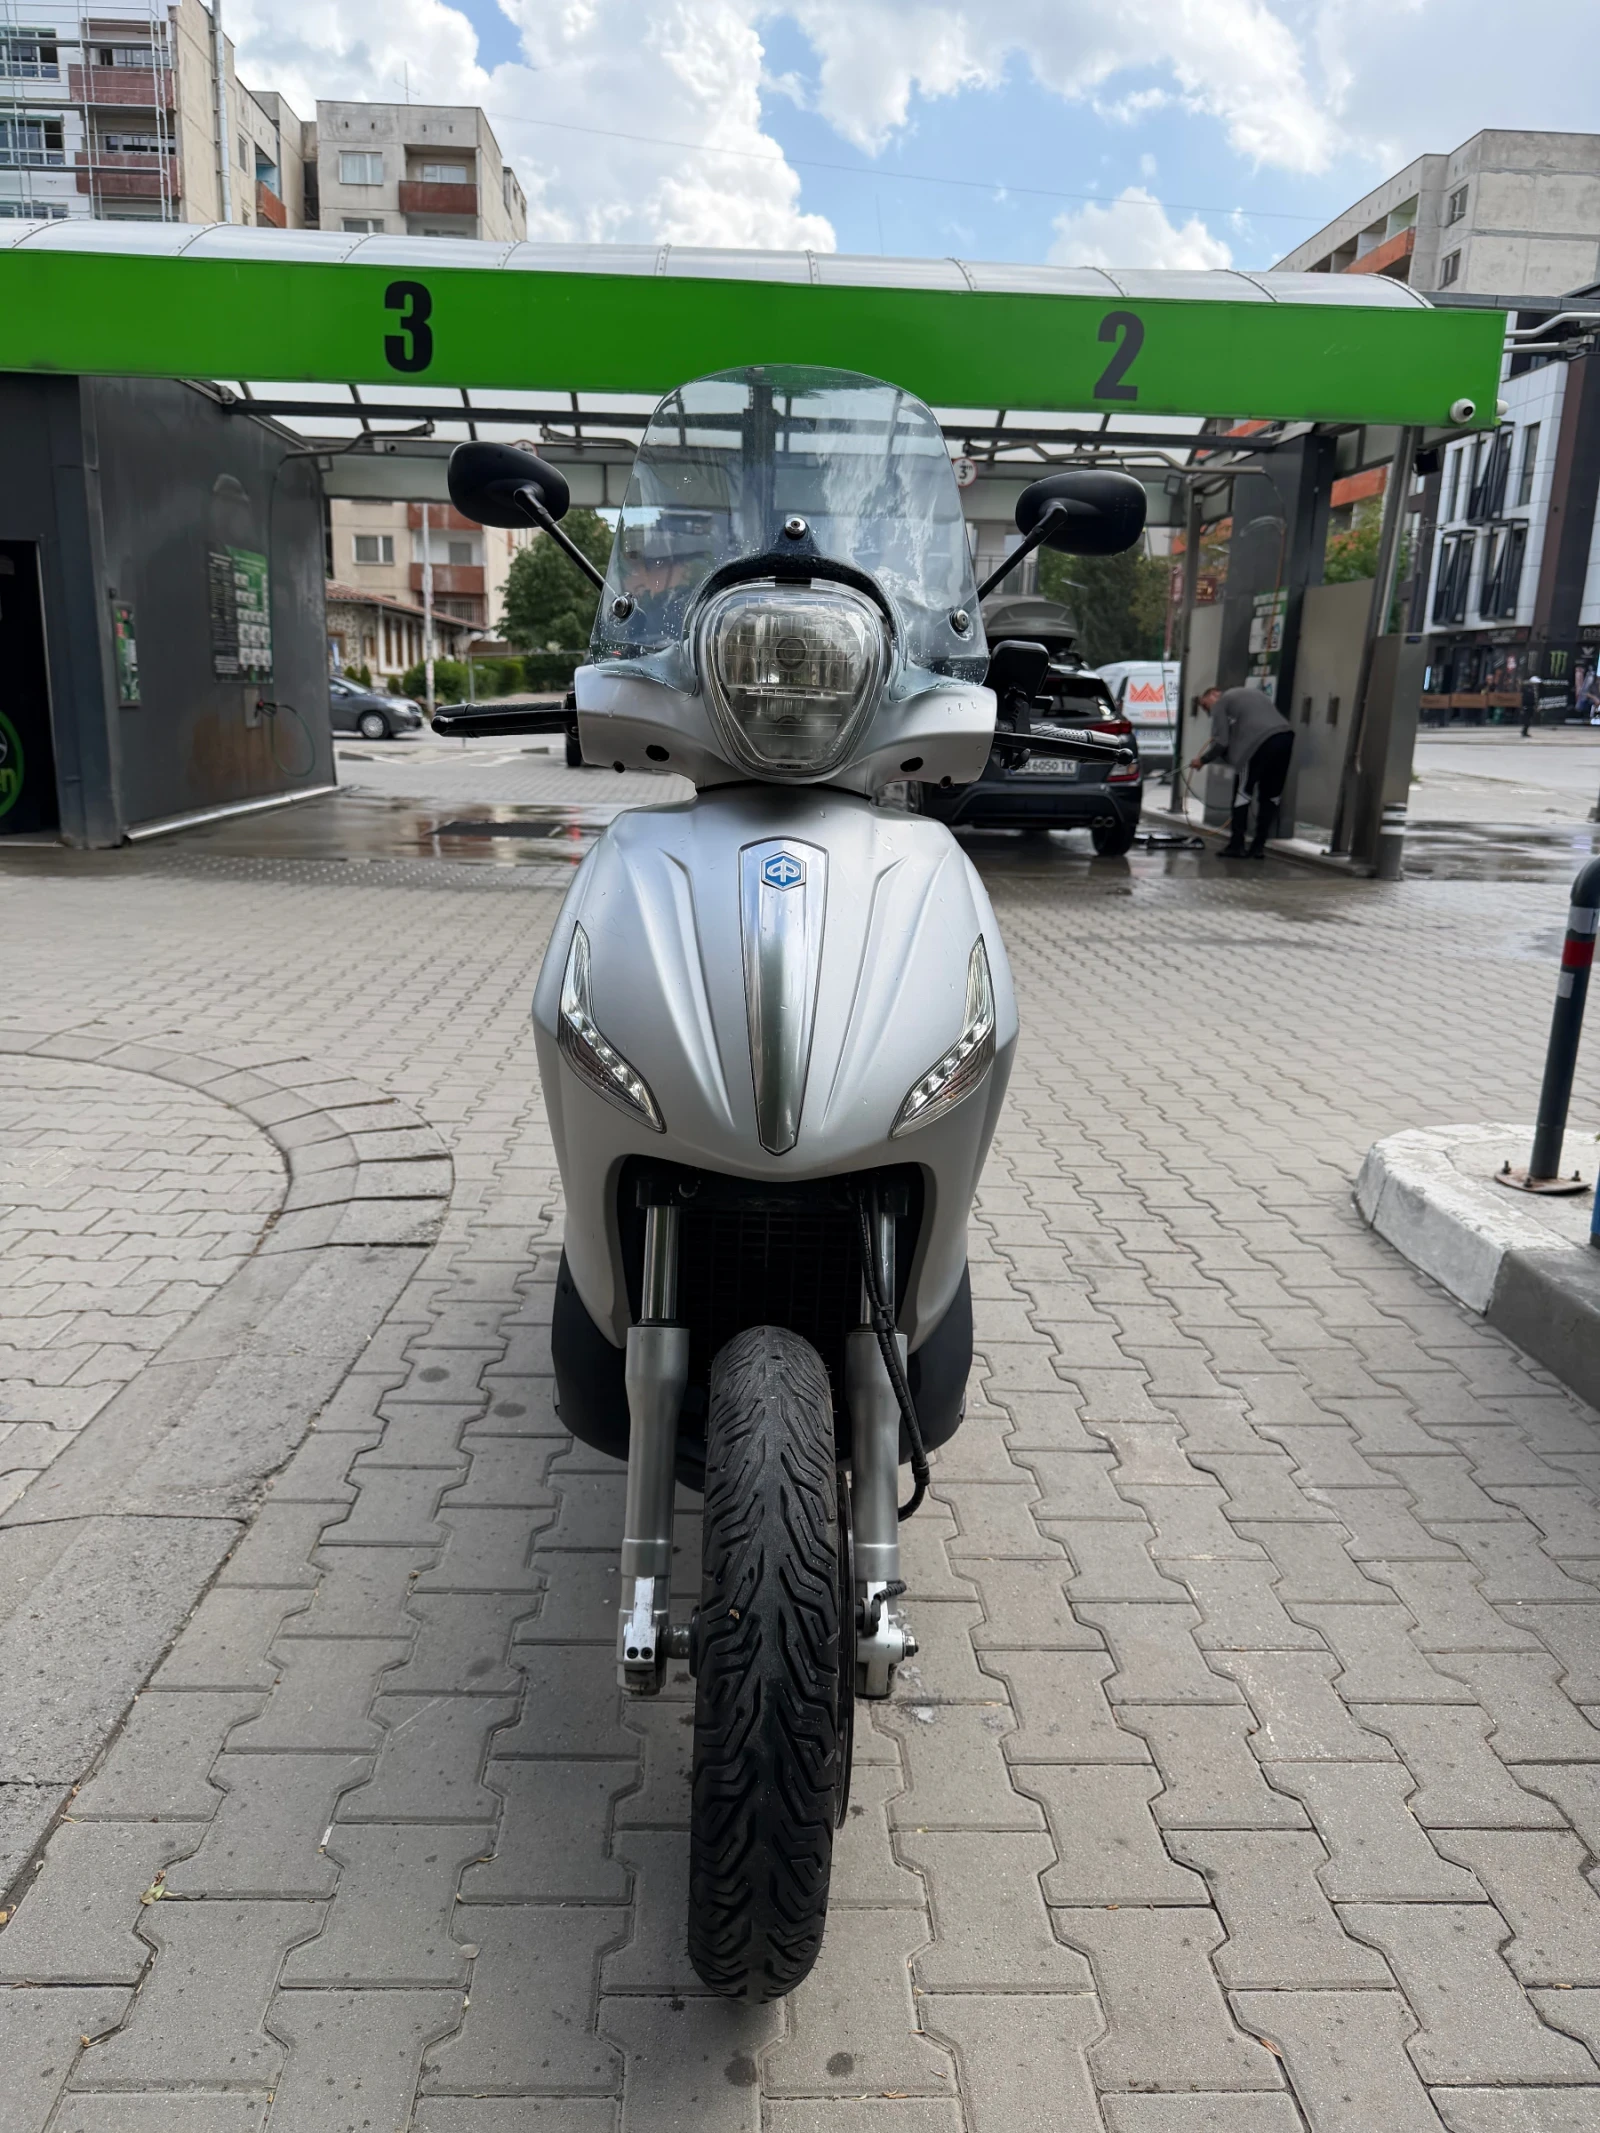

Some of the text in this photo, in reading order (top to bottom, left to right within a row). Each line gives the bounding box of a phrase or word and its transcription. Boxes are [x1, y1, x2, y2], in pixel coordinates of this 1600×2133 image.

[384, 280, 433, 373] 3
[1093, 310, 1145, 402] 2
[1033, 760, 1059, 771] 6050
[1060, 761, 1074, 771] TK
